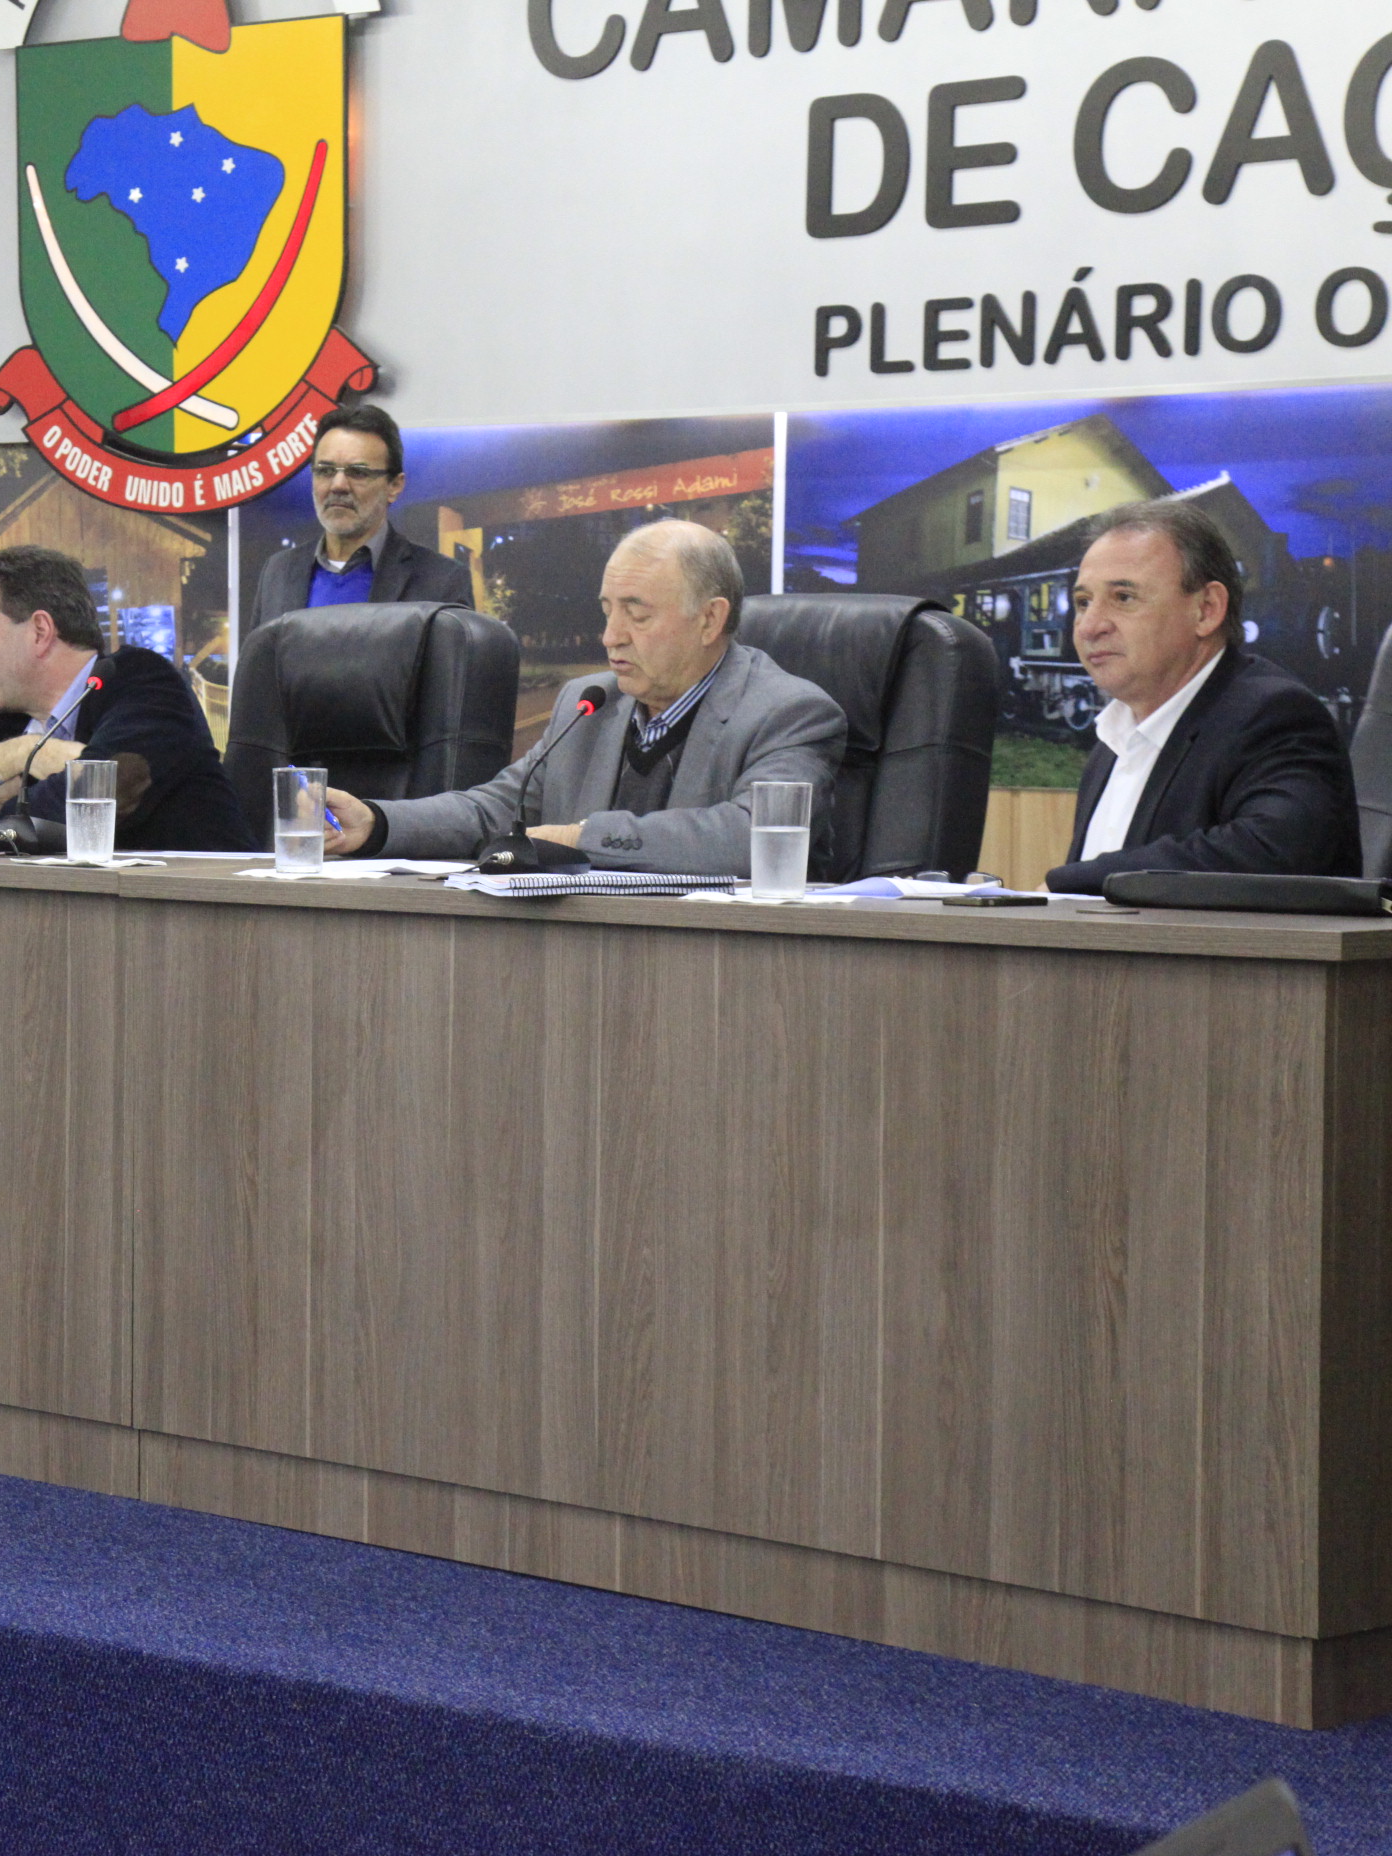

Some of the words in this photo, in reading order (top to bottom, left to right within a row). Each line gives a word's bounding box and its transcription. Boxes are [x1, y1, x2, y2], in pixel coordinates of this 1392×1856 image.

[806, 76, 1027, 240] DE
[815, 267, 1283, 378] PLENÁRIO
[42, 425, 62, 448] O
[54, 437, 114, 492] PODER
[124, 475, 185, 508] UNIDO
[193, 474, 207, 506] É
[213, 460, 264, 501] MAIS
[266, 412, 318, 475] FORTE
